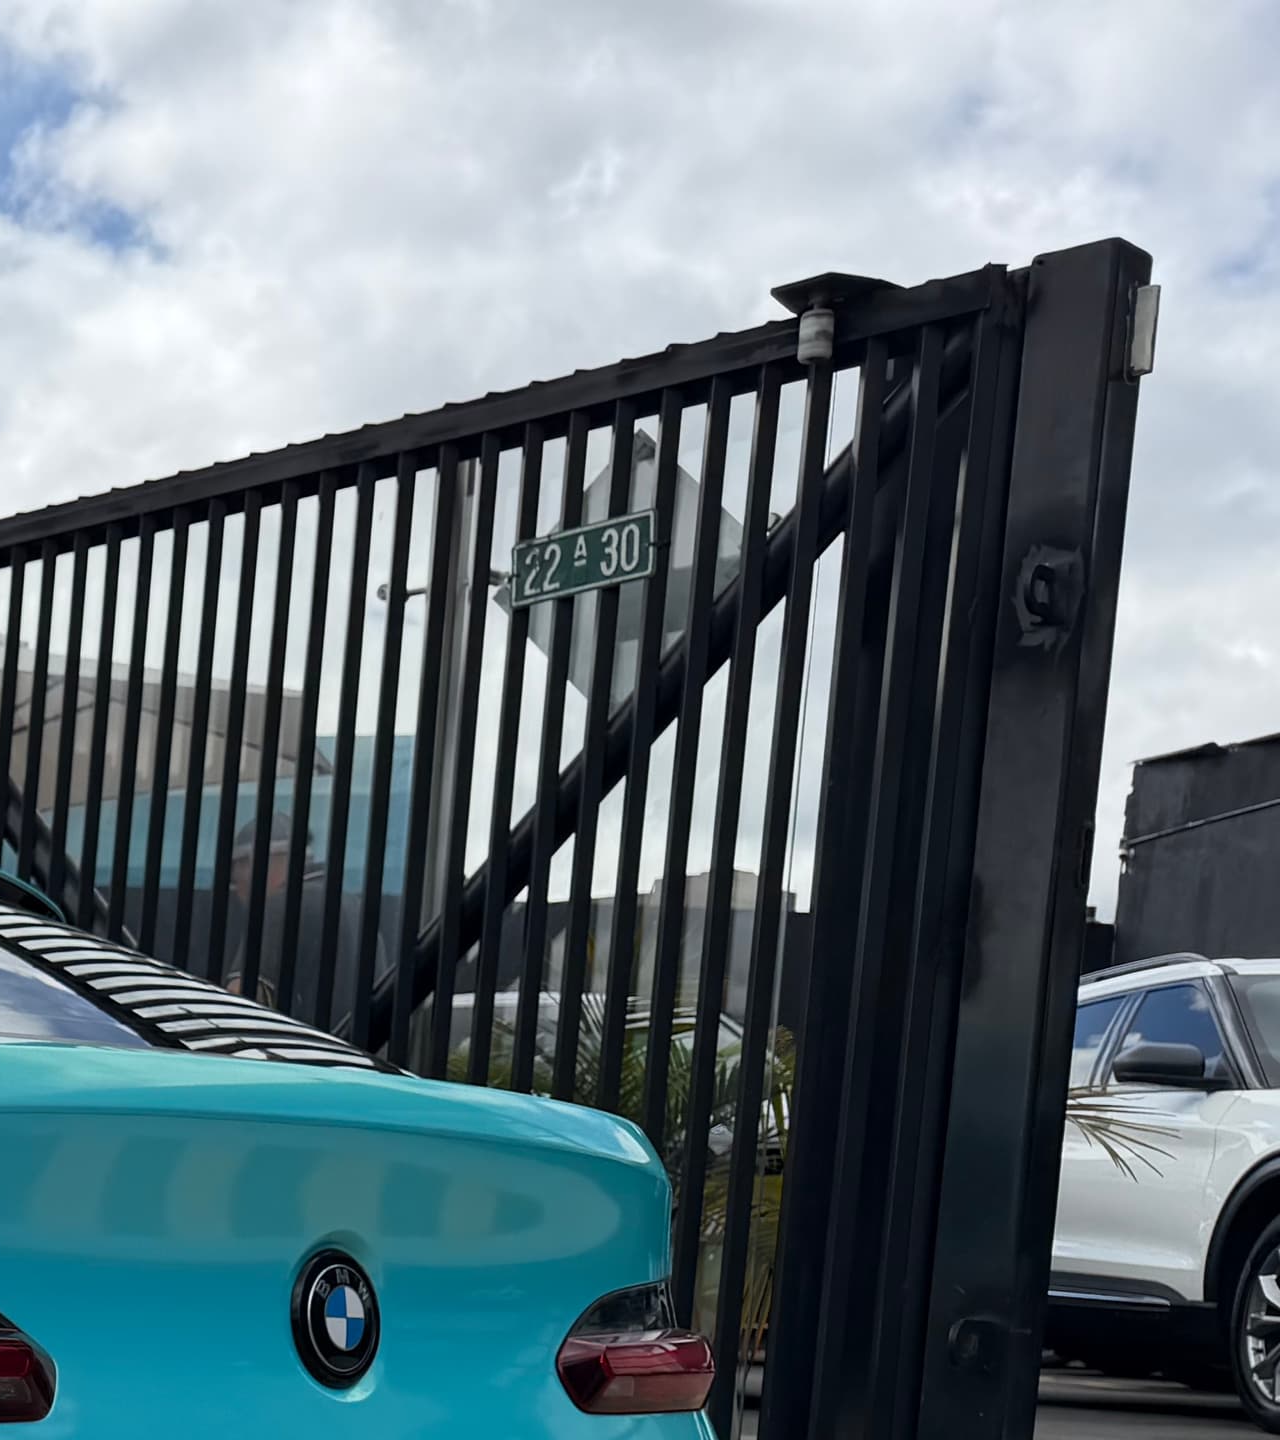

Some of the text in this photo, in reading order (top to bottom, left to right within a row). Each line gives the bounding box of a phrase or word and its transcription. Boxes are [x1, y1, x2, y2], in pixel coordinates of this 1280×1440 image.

[523, 543, 562, 596] 22
[600, 523, 641, 577] 30
[316, 1267, 370, 1300] BMW
